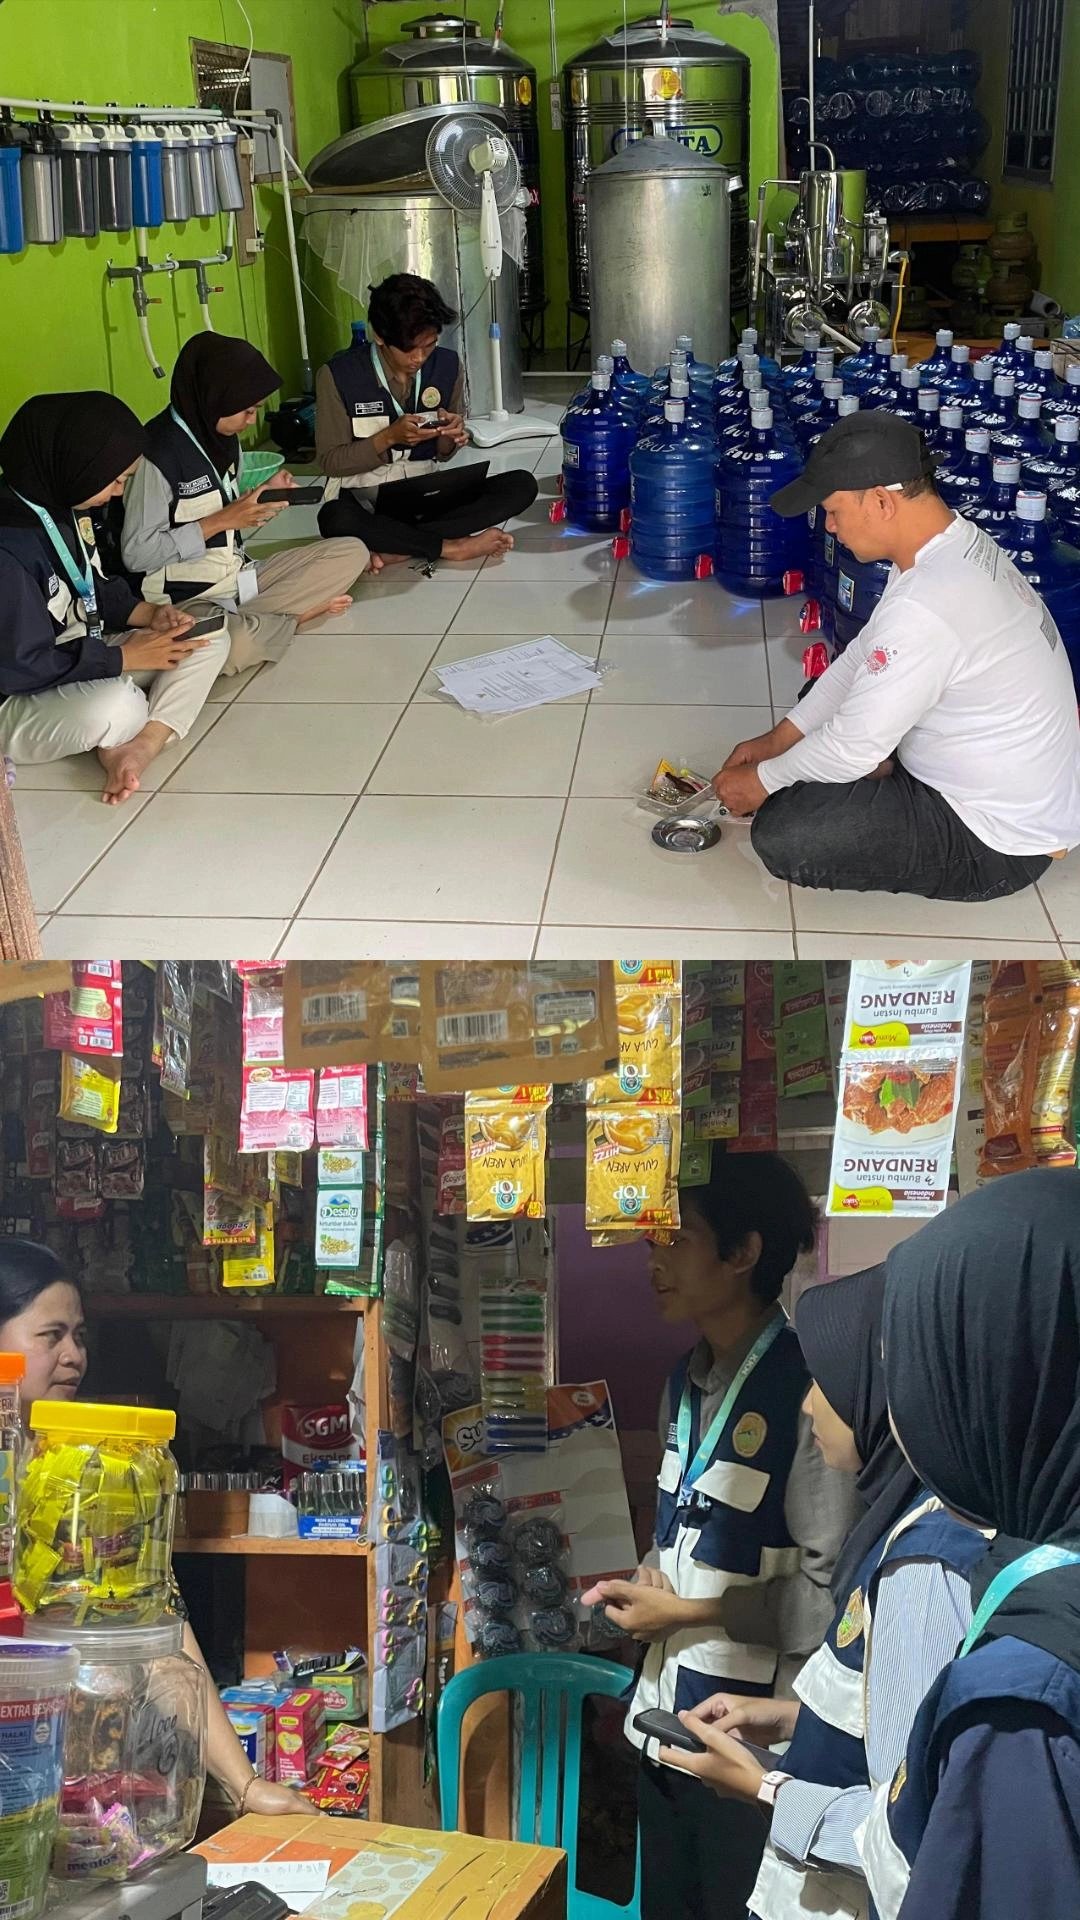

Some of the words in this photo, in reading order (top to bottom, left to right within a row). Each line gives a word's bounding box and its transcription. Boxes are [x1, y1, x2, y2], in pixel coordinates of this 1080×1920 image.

[860, 990, 956, 1009] RENDANG
[873, 1008, 902, 1017] Instan
[904, 1008, 938, 1017] Bumbu
[634, 1038, 659, 1052] GULA
[593, 1147, 620, 1163] HITZZ
[482, 1157, 507, 1168] AREN
[606, 1161, 631, 1173] AREN
[633, 1159, 659, 1172] GULA
[843, 1159, 939, 1173] RENDANG
[856, 1174, 885, 1182] Instan
[887, 1174, 921, 1184] Bumbu
[490, 1181, 524, 1194] TOP
[613, 1185, 651, 1199] TOP
[320, 1203, 359, 1219] Desaku
[303, 1414, 347, 1438] SGM
[0, 1703, 31, 1719] EXTRA
